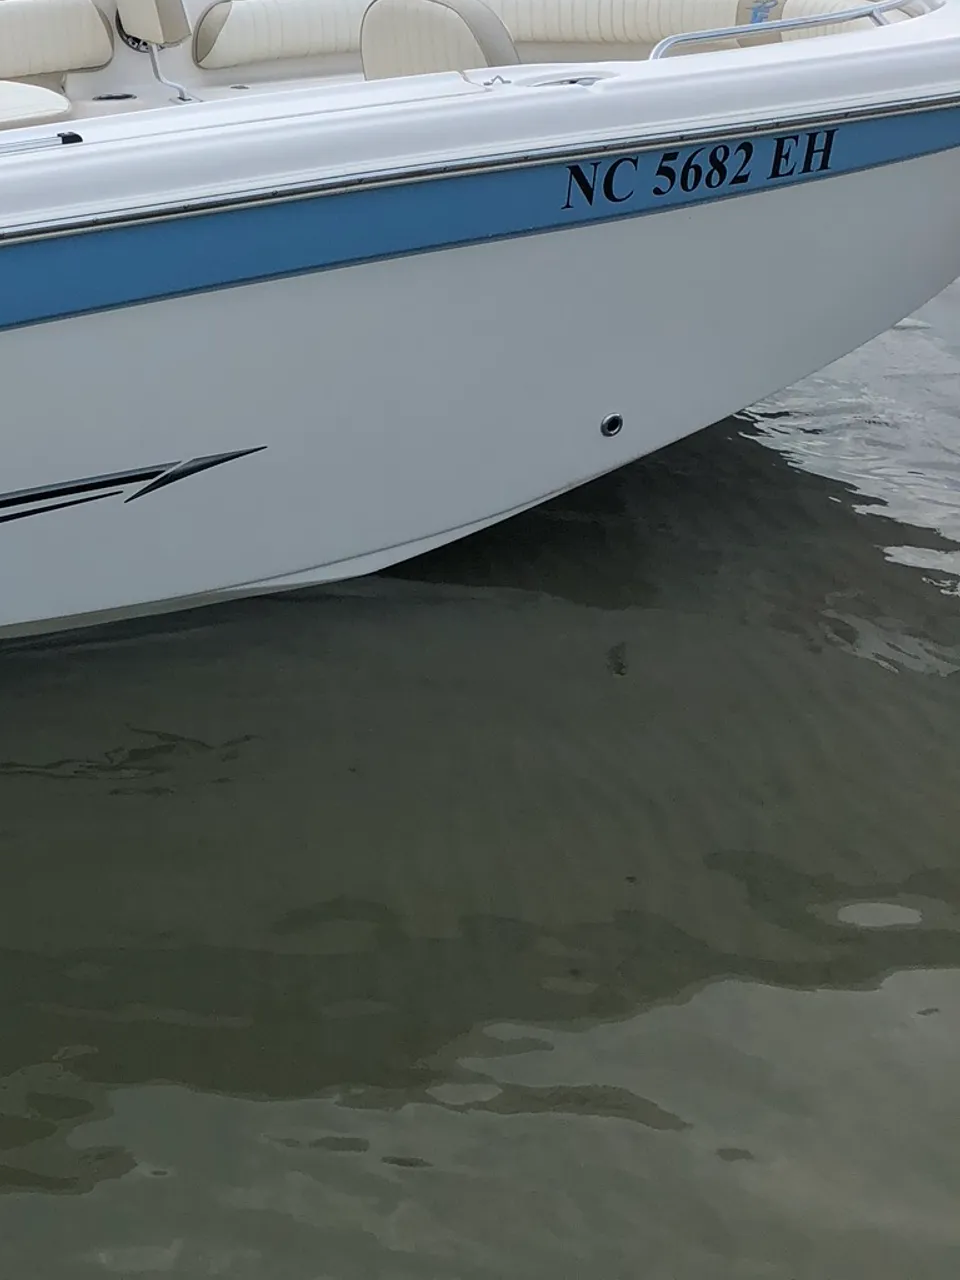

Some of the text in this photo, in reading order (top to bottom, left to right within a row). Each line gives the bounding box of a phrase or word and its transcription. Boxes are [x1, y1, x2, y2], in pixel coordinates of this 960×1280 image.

[561, 128, 839, 210] NC 5682 EH
